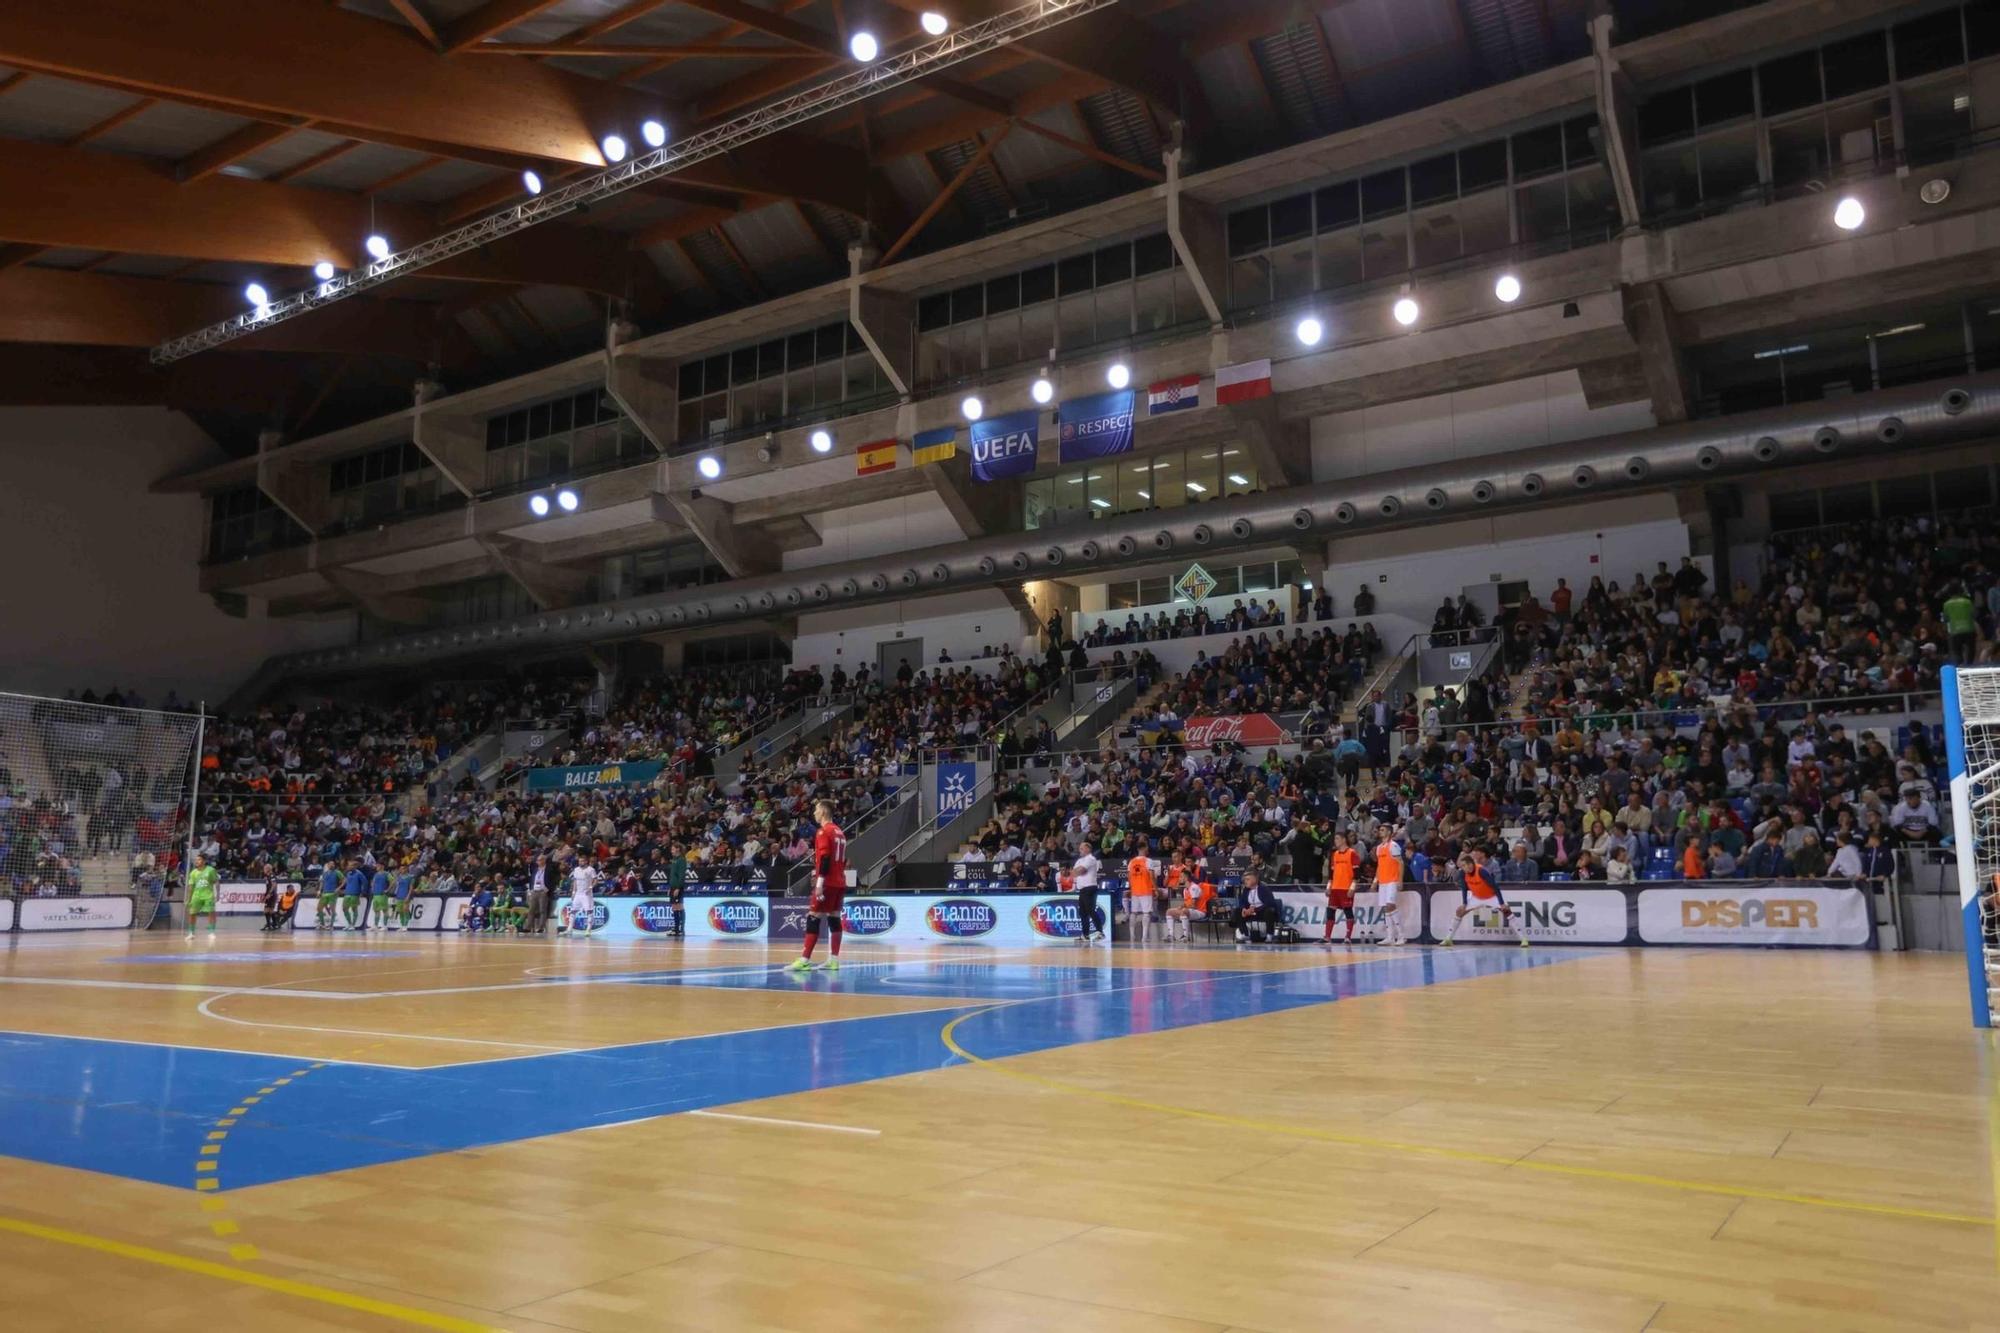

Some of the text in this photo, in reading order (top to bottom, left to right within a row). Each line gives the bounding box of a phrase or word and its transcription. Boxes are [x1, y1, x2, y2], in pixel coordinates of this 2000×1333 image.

[1078, 411, 1134, 437] RESPECT
[974, 431, 1034, 462] UEFA
[967, 872, 987, 880] COLL
[1680, 898, 1819, 929] DISPER
[1524, 928, 1578, 936] OGISTICS
